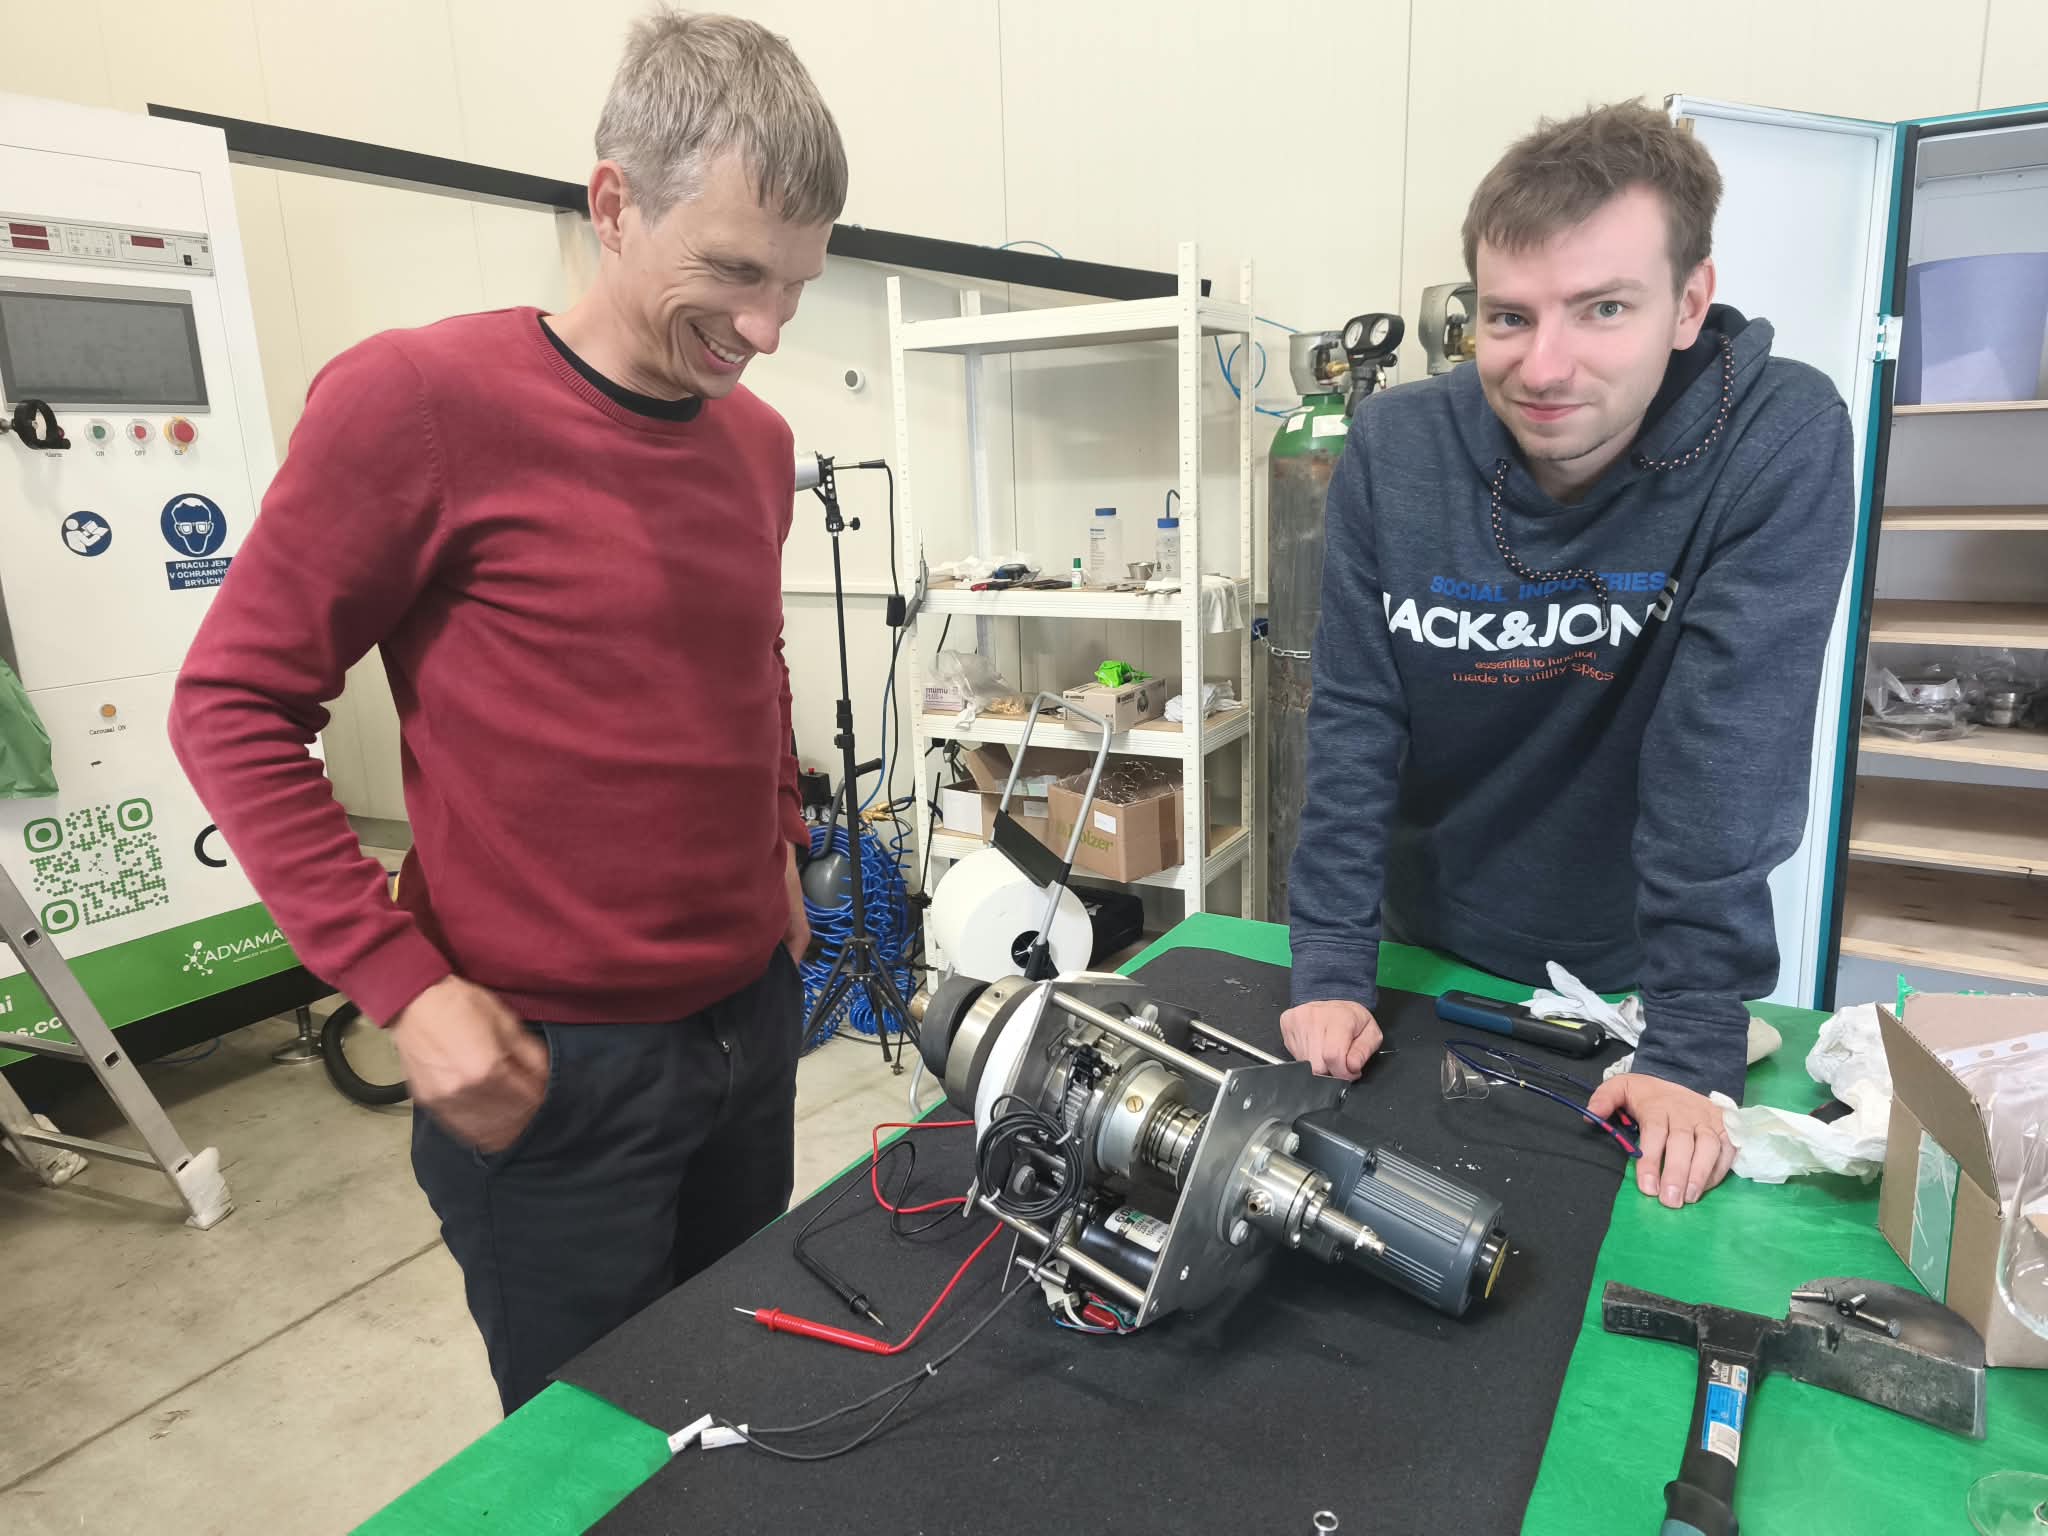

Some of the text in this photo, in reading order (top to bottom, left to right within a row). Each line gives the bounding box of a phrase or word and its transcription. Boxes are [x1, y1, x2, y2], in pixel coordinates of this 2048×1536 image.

[175, 560, 227, 570] PRACUJ JEN
[1430, 575, 1507, 603] SOCIAL
[1475, 657, 1530, 669] essential
[1533, 658, 1545, 668] to
[1453, 672, 1498, 684] made
[1503, 673, 1520, 684] to
[203, 928, 285, 965] ADVAMA
